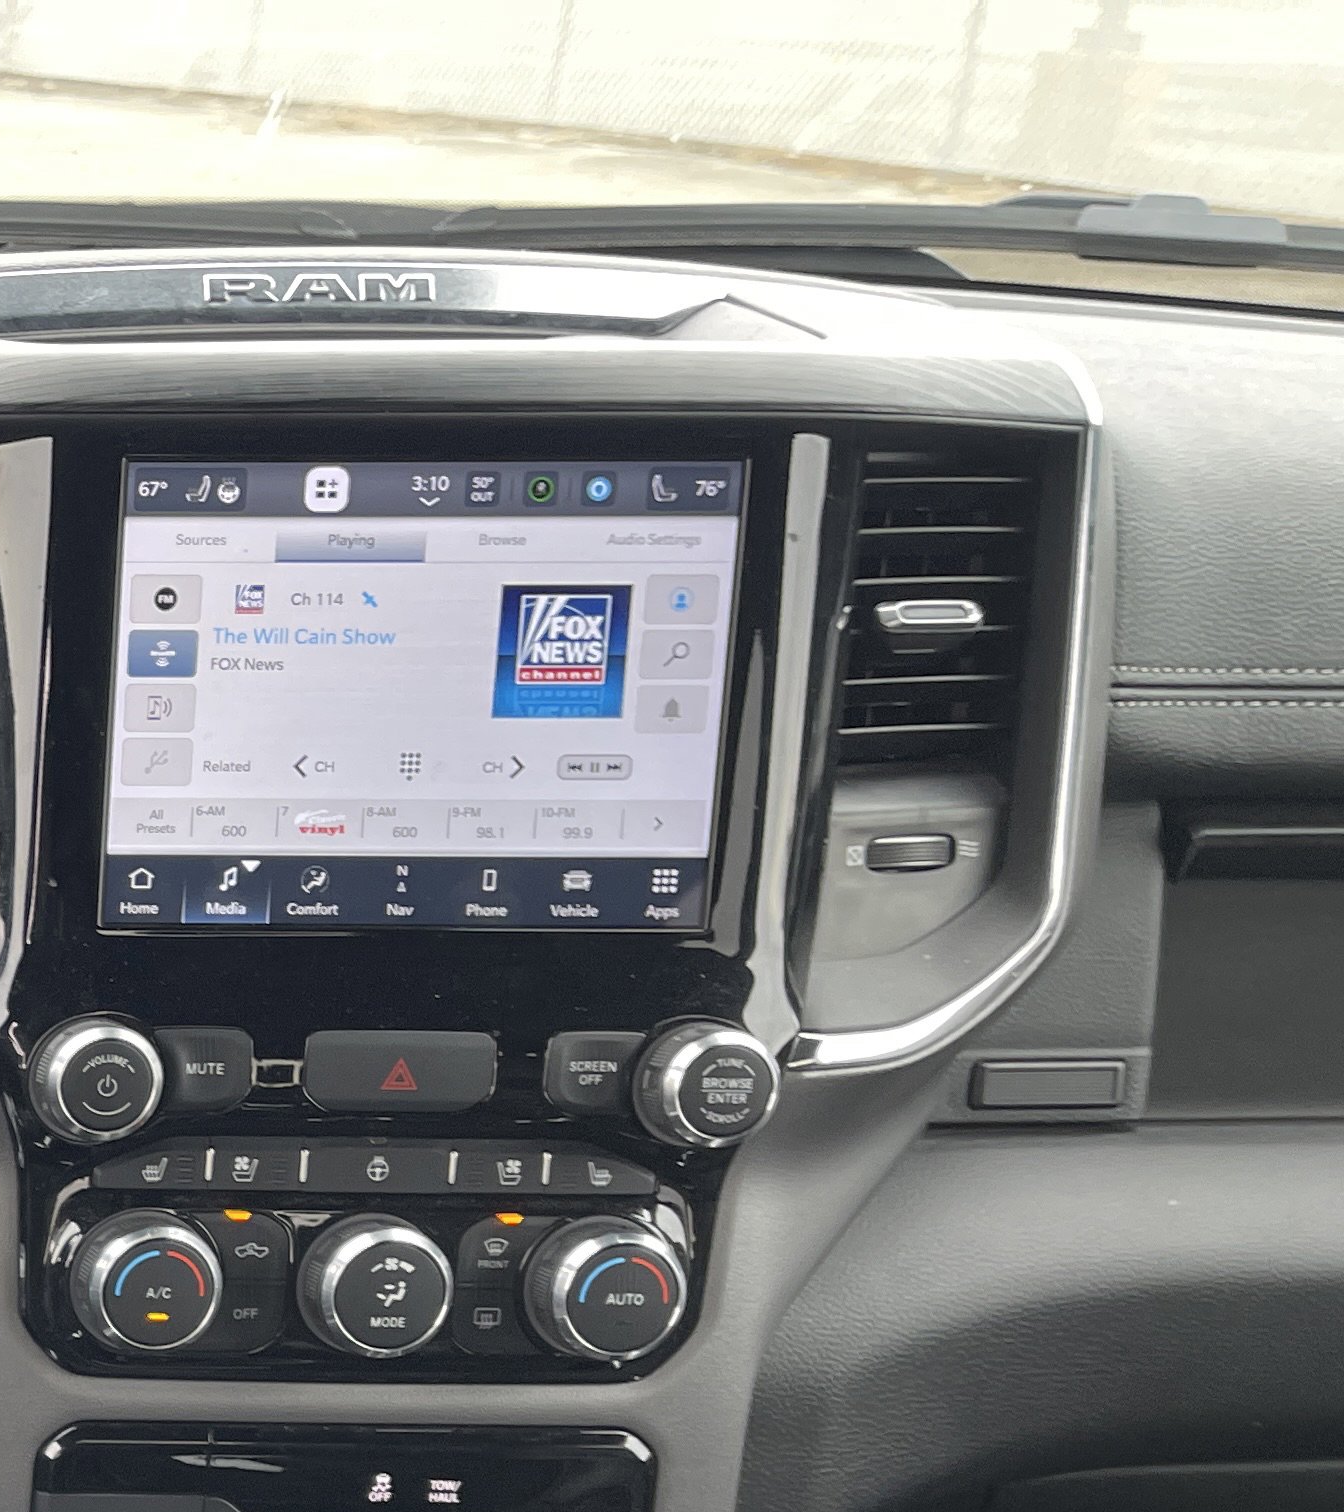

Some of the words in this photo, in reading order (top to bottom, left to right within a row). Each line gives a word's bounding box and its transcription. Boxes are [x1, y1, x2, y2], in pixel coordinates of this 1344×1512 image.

[202, 273, 436, 303] RAM
[411, 475, 450, 492] 3:10
[470, 490, 495, 503] OUT
[176, 534, 226, 546] Sources
[328, 533, 375, 549] Playing
[478, 533, 527, 547] Browse
[607, 533, 645, 546] Audio
[649, 534, 702, 548] Settings
[290, 592, 311, 607] Ch
[317, 592, 344, 606] 114
[548, 615, 604, 640] FOX
[213, 627, 247, 645] The
[254, 627, 289, 645] Will
[295, 627, 337, 645] Cain
[343, 628, 396, 645] Show
[530, 641, 602, 664] NEWS
[210, 657, 240, 671] FOX
[244, 658, 284, 671] News
[521, 669, 600, 680] channel
[203, 760, 251, 773] Related
[314, 760, 336, 773] CH
[482, 761, 504, 774] CH
[149, 808, 164, 821] All
[196, 806, 226, 817] 6-AM
[281, 805, 289, 816] 7
[136, 823, 176, 835] Presets
[221, 825, 247, 837] 600
[298, 824, 345, 836] vinyl
[392, 826, 418, 838] 600
[476, 827, 504, 839] 98.1
[396, 865, 408, 876] N
[119, 902, 159, 915] Home
[205, 901, 247, 915] Media
[286, 901, 339, 916] Comfort
[386, 903, 414, 916] Nav
[465, 903, 508, 917] Phone
[549, 903, 599, 918] Vehicle
[644, 904, 680, 920] Apps
[88, 1053, 130, 1069] VOLUME
[568, 1060, 618, 1074] SCREEN
[716, 1058, 746, 1069] TUNE
[185, 1062, 226, 1076] MUTE
[577, 1074, 604, 1086] OFF
[702, 1077, 754, 1090] BROWSE
[706, 1093, 747, 1105] ENTER
[145, 1287, 172, 1300] A/C
[605, 1293, 645, 1306] AUTO
[232, 1308, 258, 1320] OFF
[369, 1316, 406, 1328] MODE
[430, 1480, 462, 1491] TOW/
[368, 1491, 392, 1502] OFF
[428, 1492, 460, 1503] HAUL
